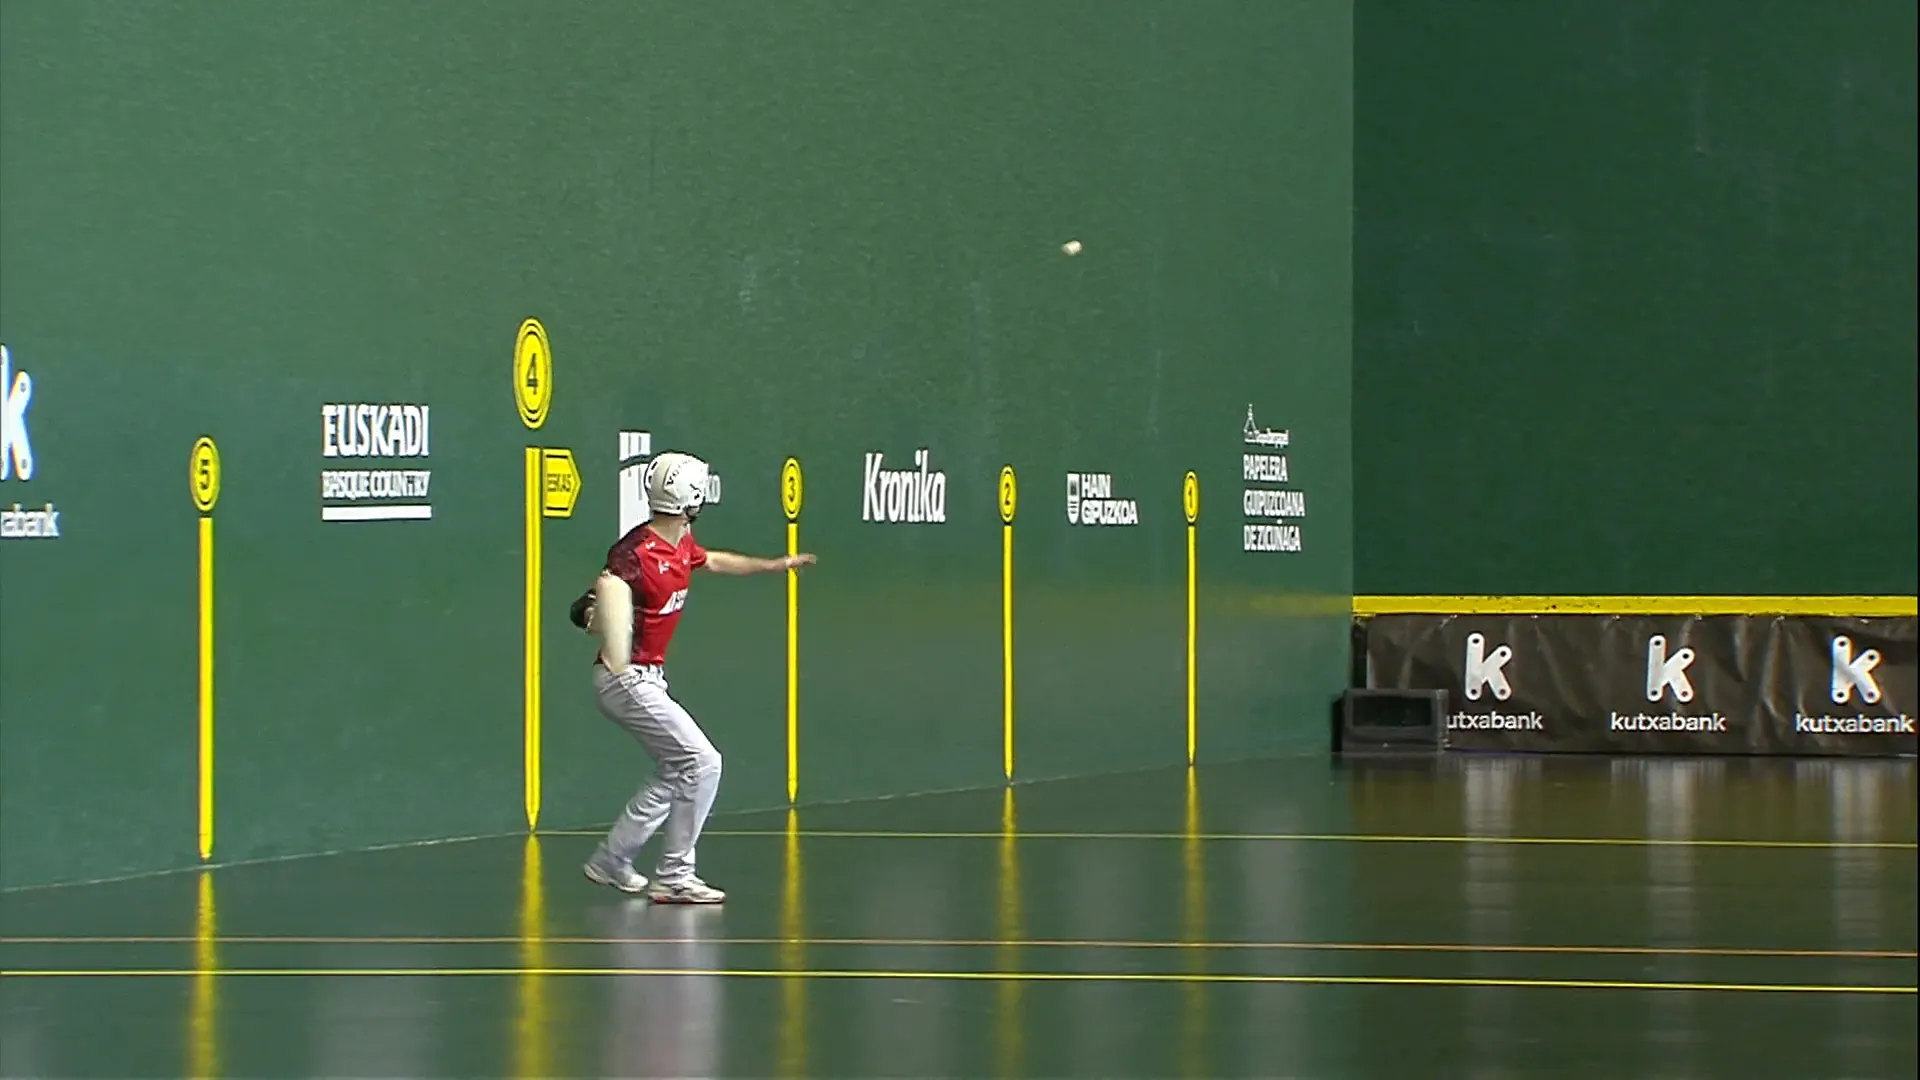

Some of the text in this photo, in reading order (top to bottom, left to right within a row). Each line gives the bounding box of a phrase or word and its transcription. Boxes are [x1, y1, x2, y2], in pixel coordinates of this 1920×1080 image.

[526, 353, 539, 395] 4
[322, 404, 430, 456] EUSKADI
[199, 459, 211, 490] 5
[1243, 454, 1288, 481] PAPELERA
[322, 469, 431, 500] BASQUE COUNTRY
[862, 449, 947, 523] Kronika
[1081, 473, 1111, 498] HAIN
[0, 503, 60, 537] abank
[1465, 632, 1512, 700] k
[1647, 635, 1695, 702] k
[1831, 635, 1881, 703] k
[1446, 711, 1544, 730] utxabank
[1611, 712, 1727, 732] kutxabank
[1796, 713, 1915, 734] kutxabank
